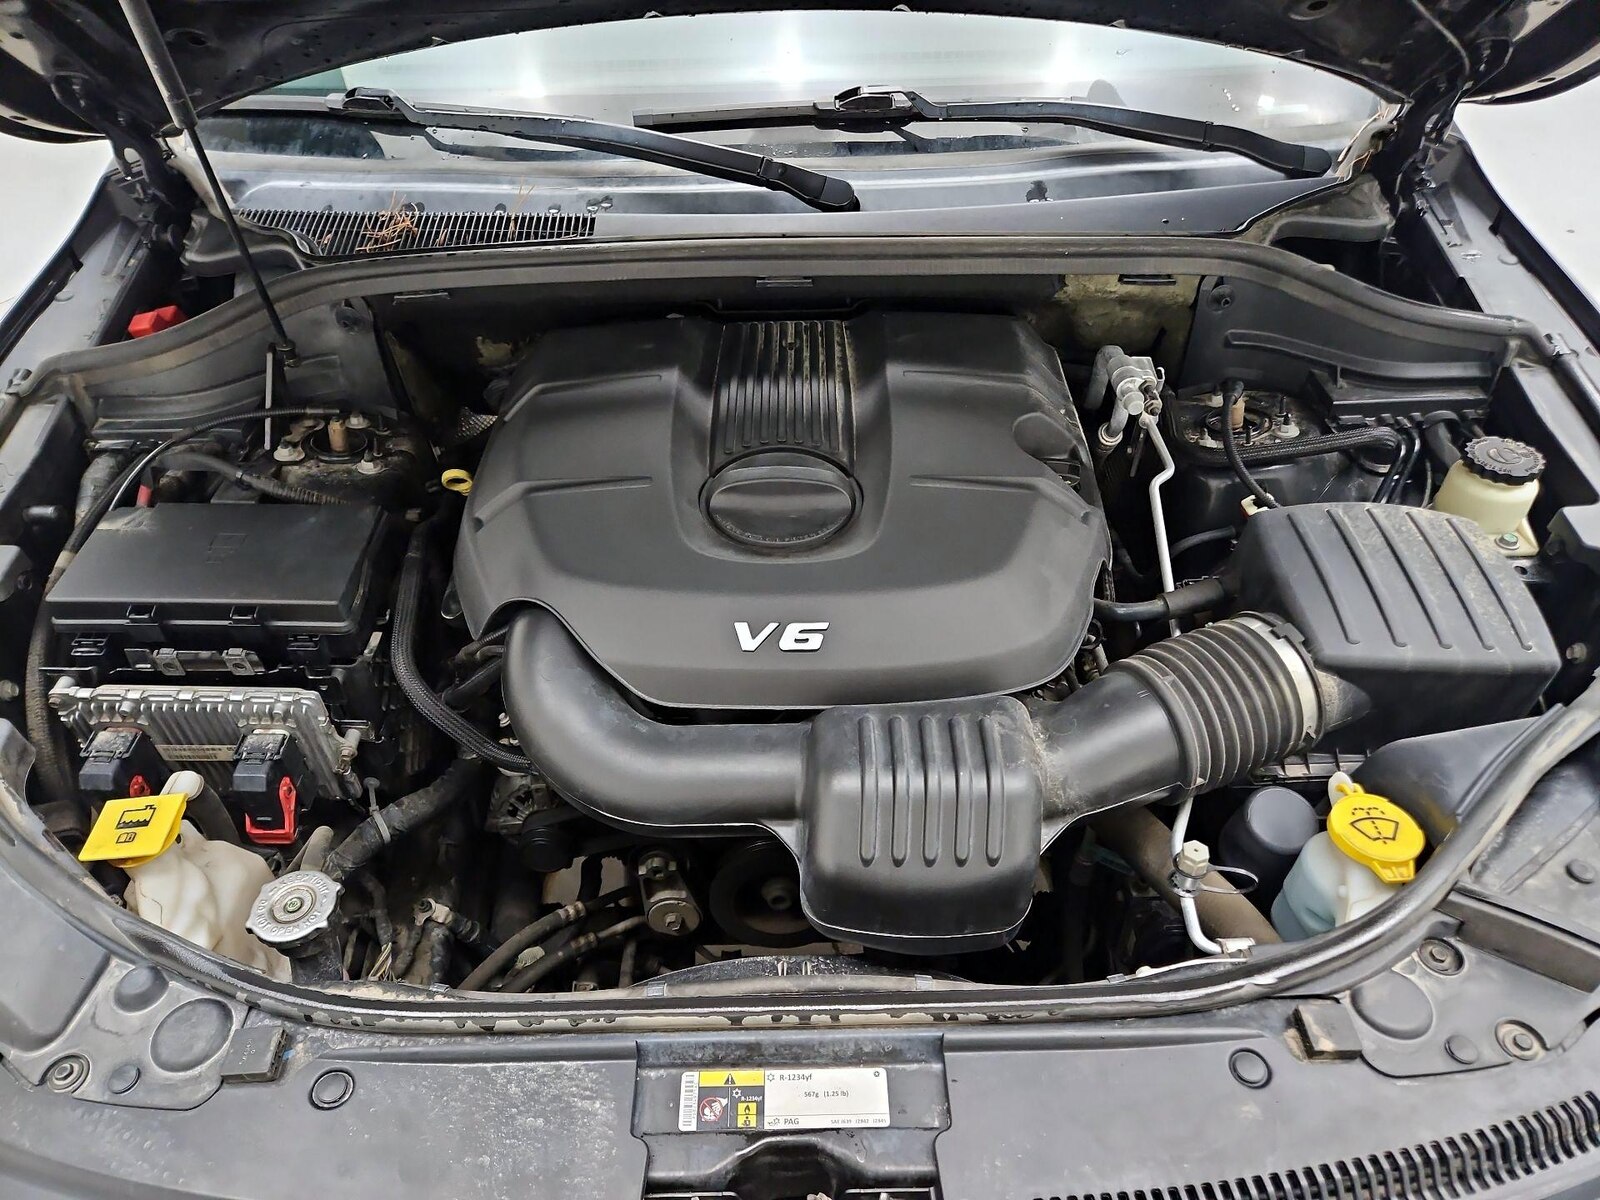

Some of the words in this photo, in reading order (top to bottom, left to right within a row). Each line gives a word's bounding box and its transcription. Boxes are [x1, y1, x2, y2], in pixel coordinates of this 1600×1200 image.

[733, 621, 831, 652] V6
[258, 899, 269, 912] DO
[255, 913, 271, 930] NOT
[779, 1073, 812, 1082] R-1234yf
[823, 1090, 839, 1098] (1.25
[784, 1117, 799, 1125] PAG
